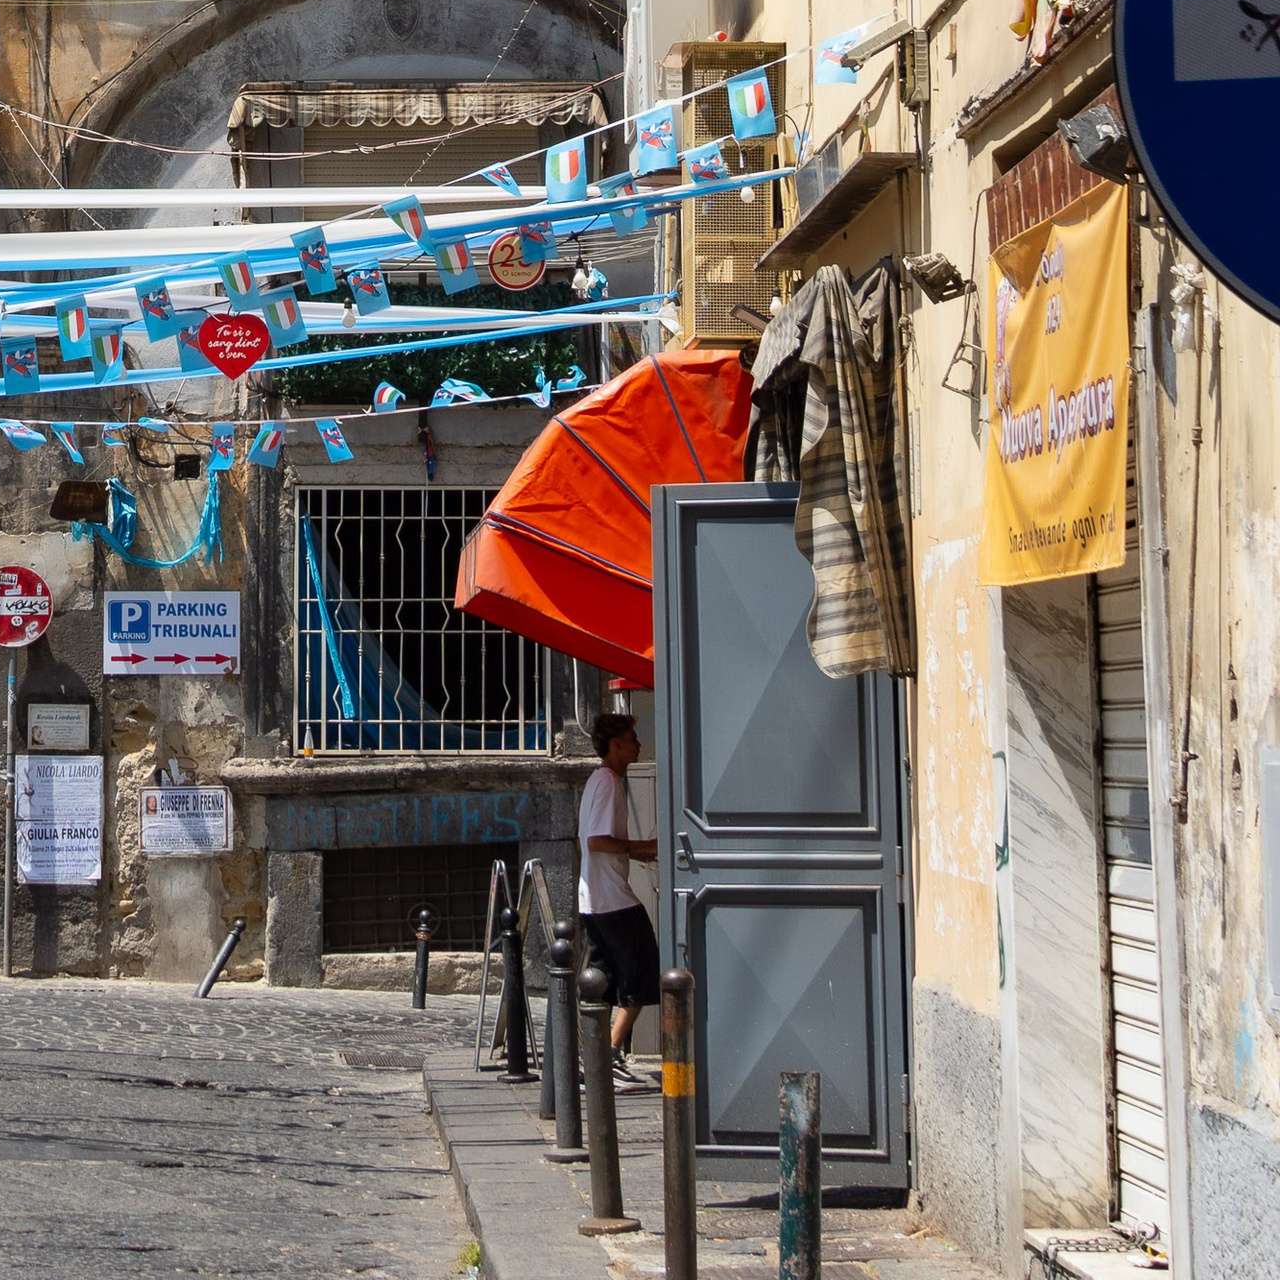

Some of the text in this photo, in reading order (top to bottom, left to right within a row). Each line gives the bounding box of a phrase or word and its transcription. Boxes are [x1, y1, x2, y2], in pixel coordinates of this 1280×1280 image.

[217, 325, 231, 338] Tu
[208, 341, 233, 353] sang
[1000, 372, 1115, 464] Nuova Apertura
[1072, 506, 1097, 548] ogni
[158, 603, 227, 616] PARKING
[122, 603, 142, 631] P
[113, 632, 146, 640] PARKING
[152, 624, 236, 638] TRIBUNALI
[36, 765, 99, 778] NICOLA LIARDO
[161, 795, 189, 811] GIUSEPPE
[192, 795, 200, 811] DI
[28, 827, 99, 840] GIULIA FRANCO
